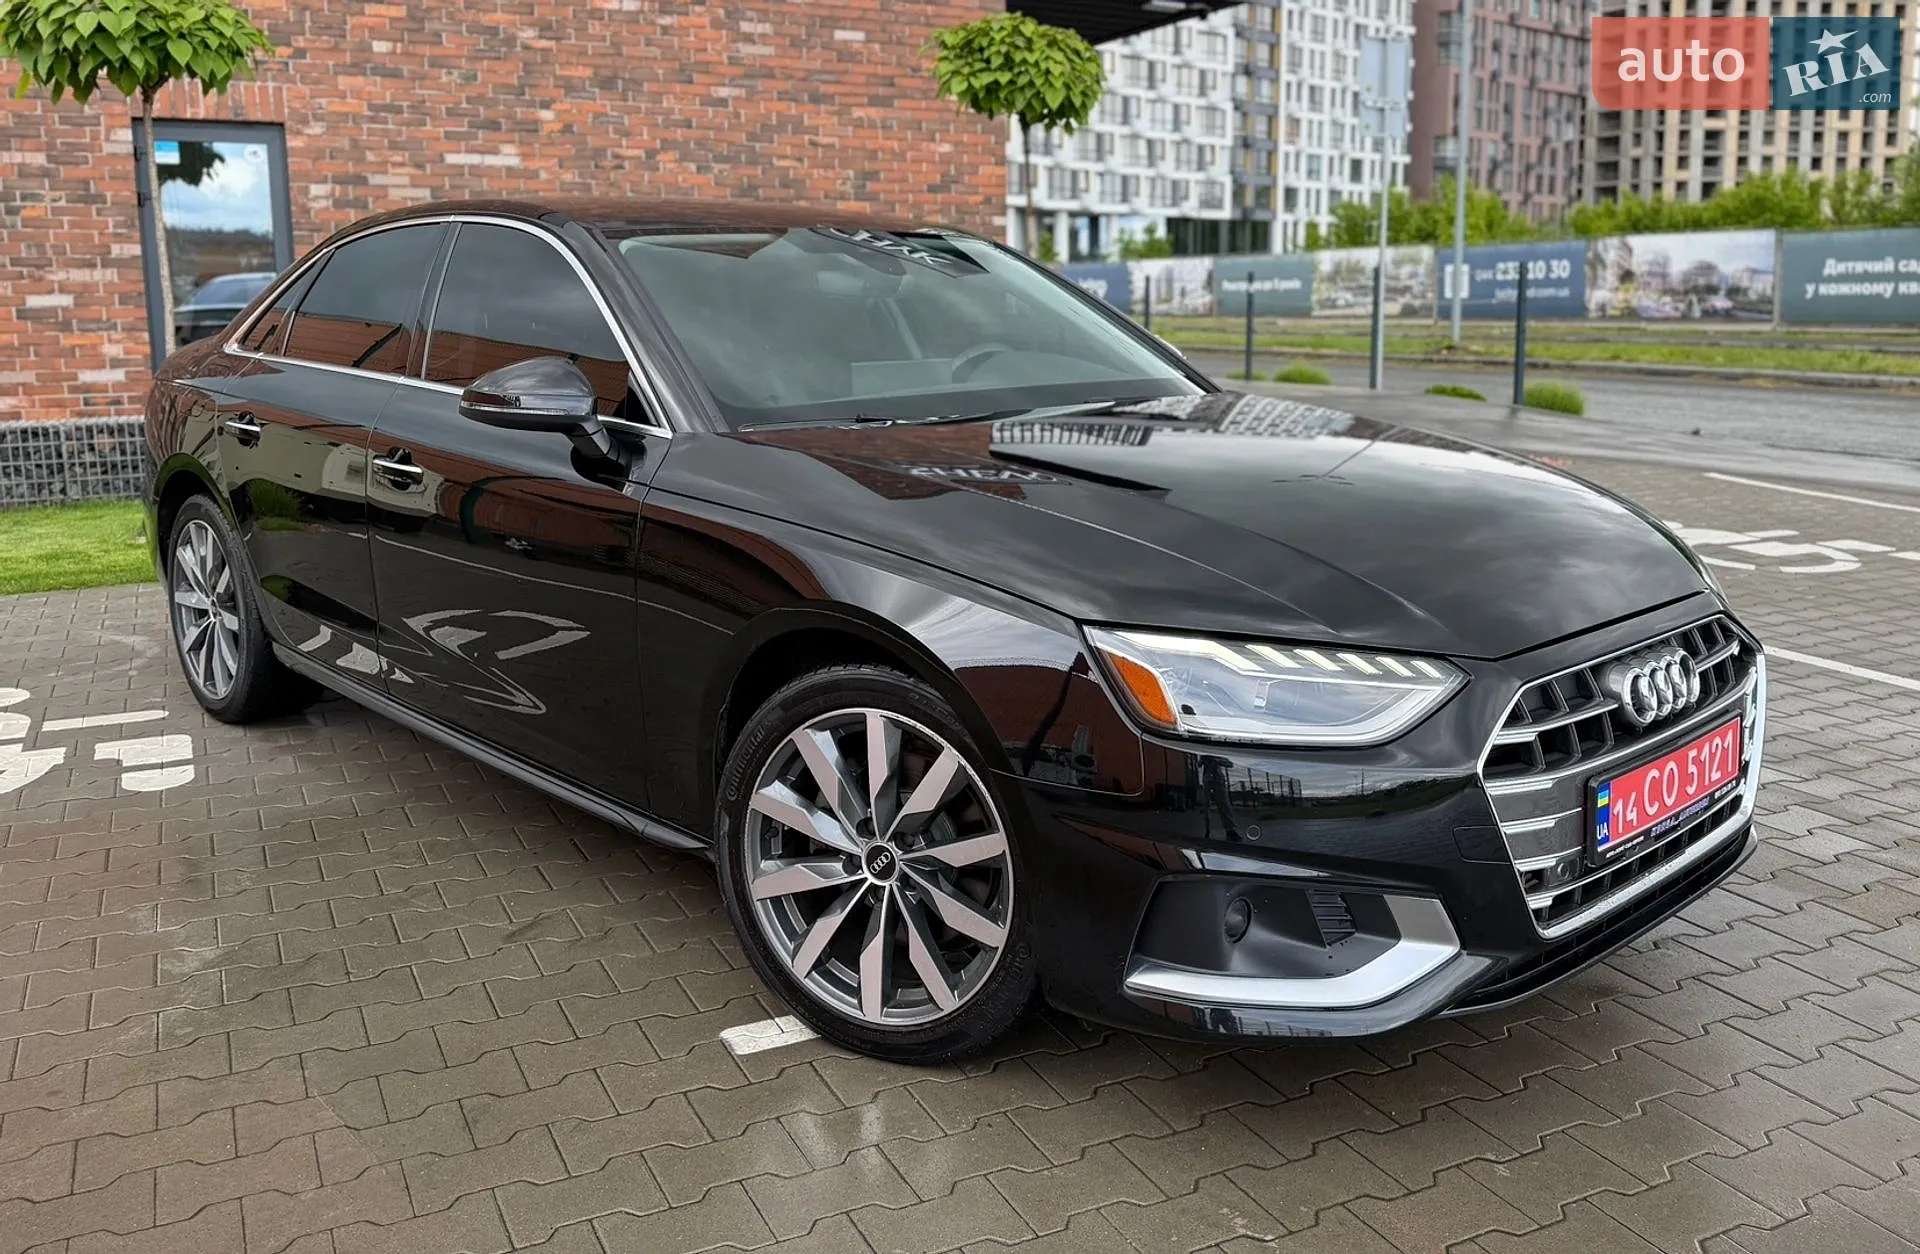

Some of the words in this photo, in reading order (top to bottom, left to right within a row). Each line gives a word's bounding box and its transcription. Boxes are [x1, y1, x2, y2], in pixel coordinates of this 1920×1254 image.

[1548, 257, 1571, 280] 30
[1822, 256, 1895, 277] Дитячий
[1898, 258, 1920, 275] са
[1804, 283, 1817, 300] у
[1818, 282, 1895, 299] кожному
[1898, 281, 1920, 295] кв
[1613, 792, 1638, 834] 14
[1685, 729, 1734, 796] 5121
[1596, 821, 1609, 840] UA
